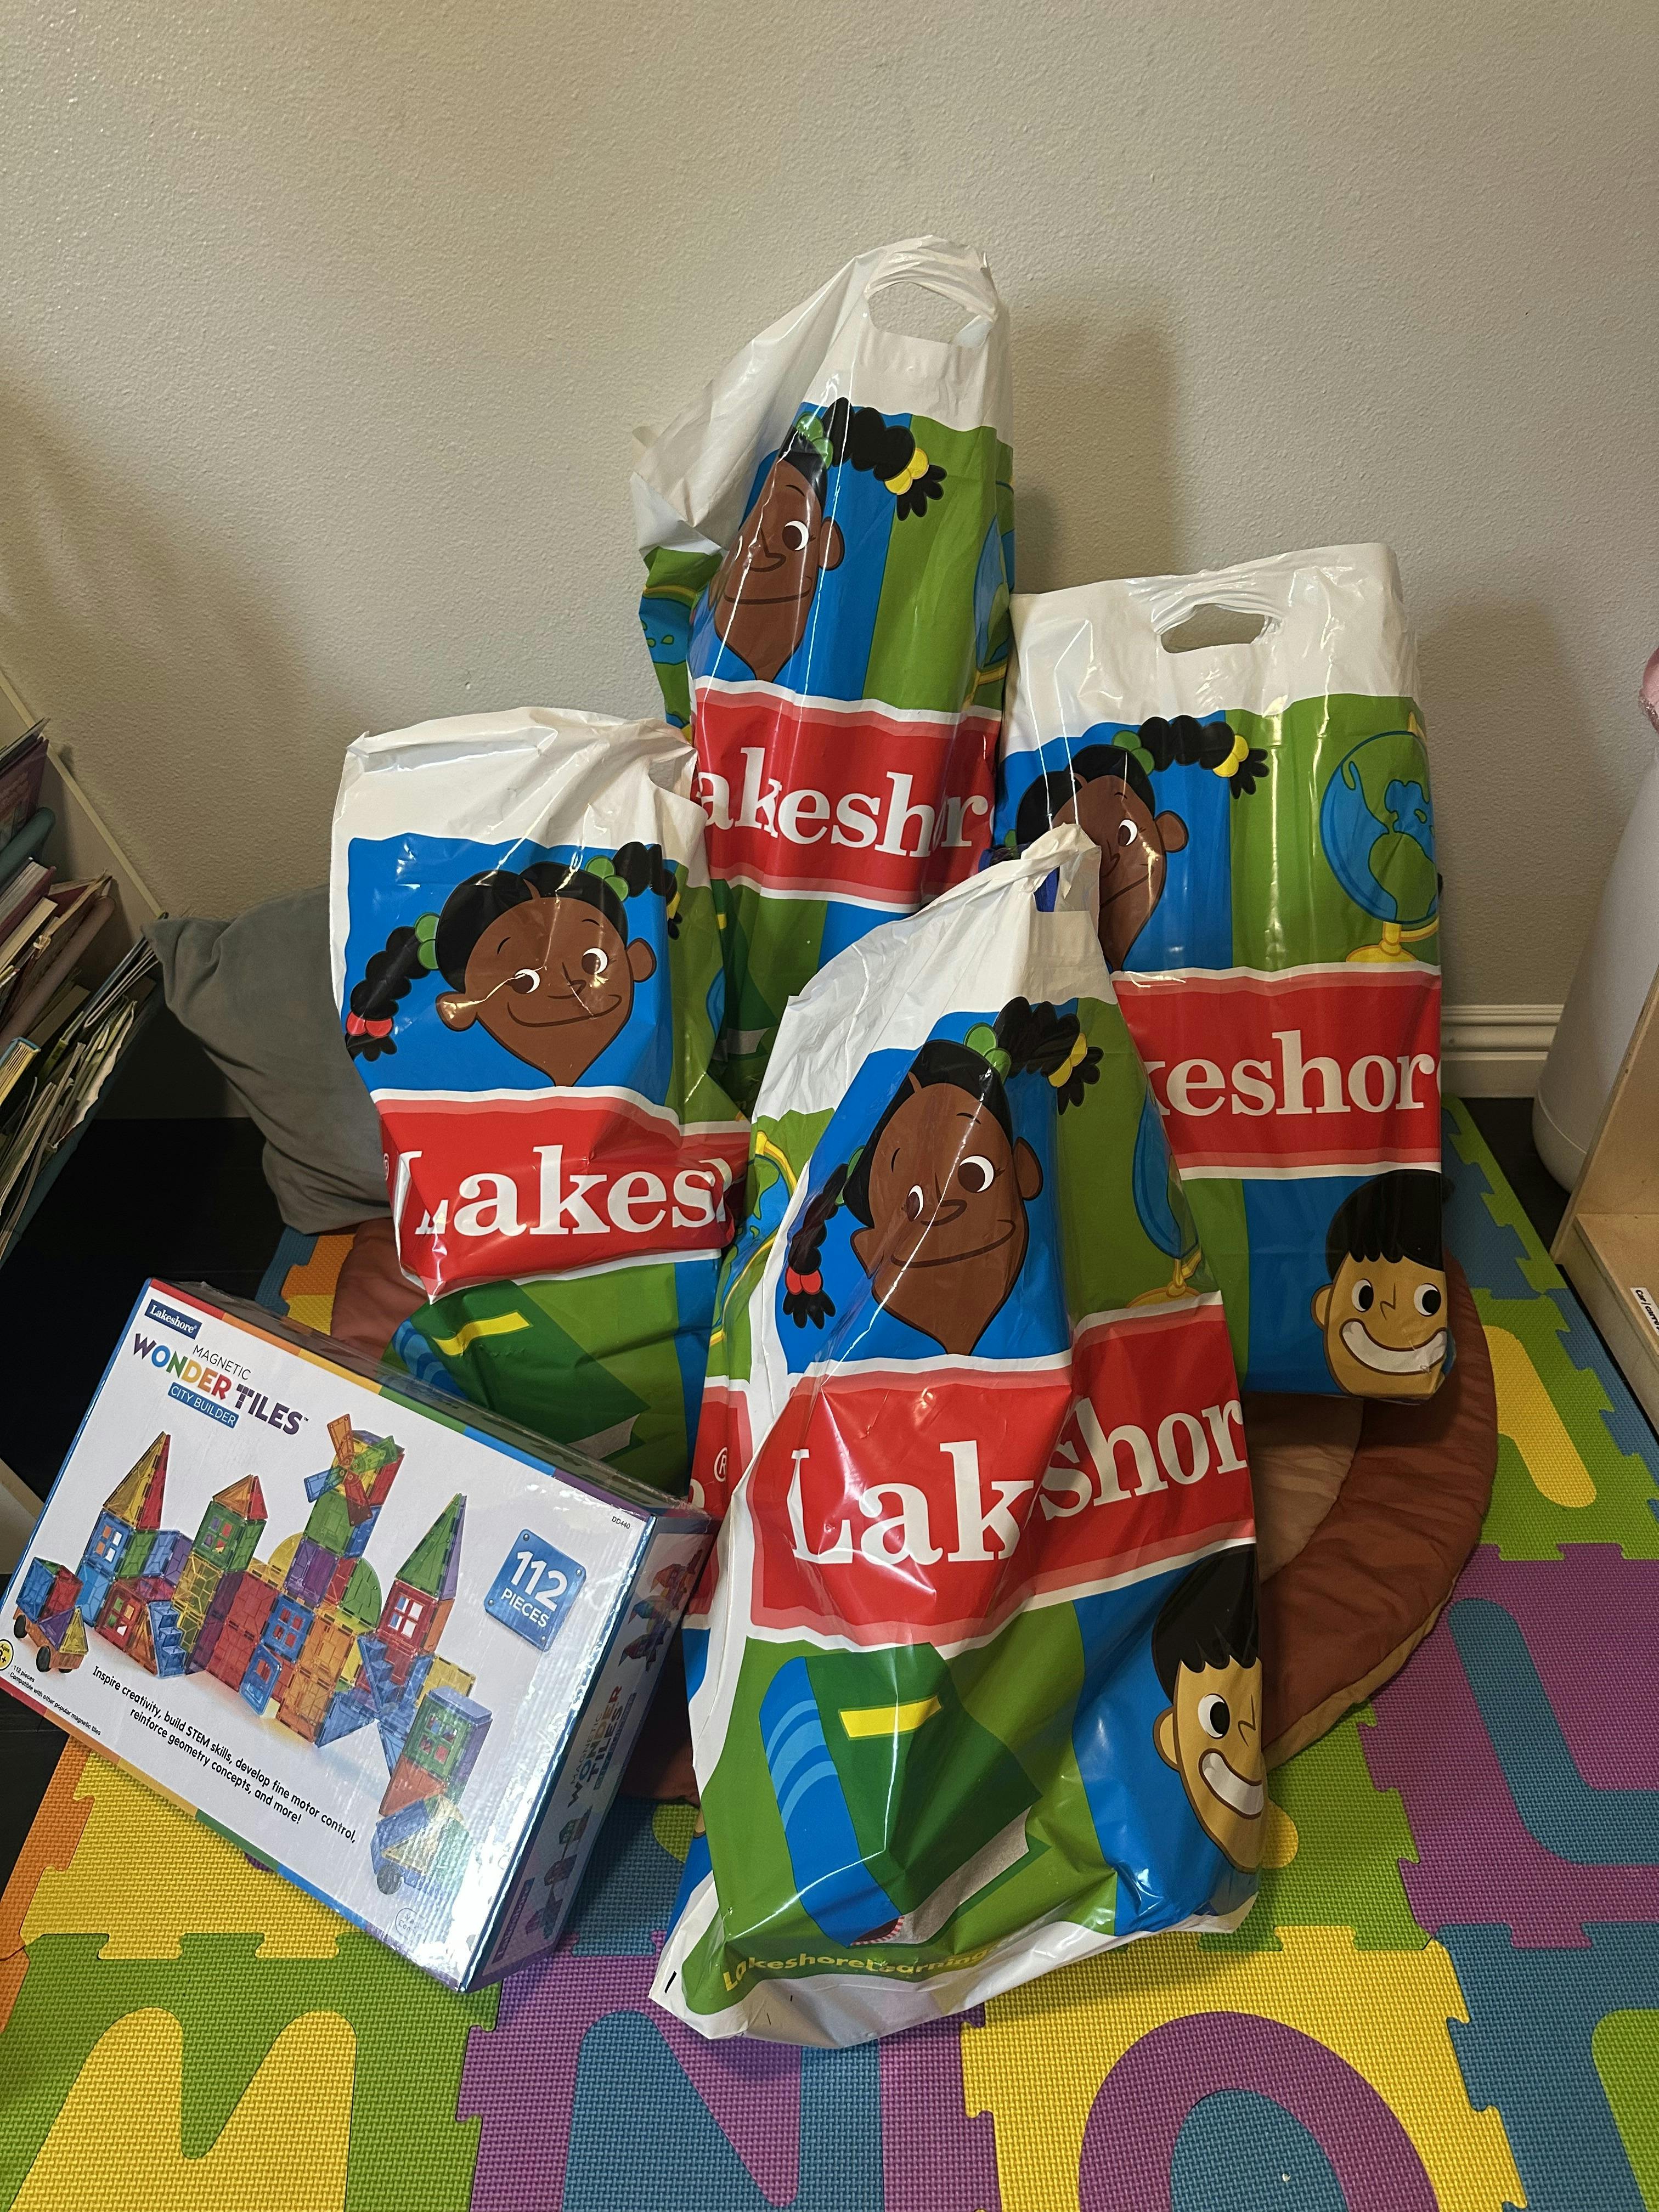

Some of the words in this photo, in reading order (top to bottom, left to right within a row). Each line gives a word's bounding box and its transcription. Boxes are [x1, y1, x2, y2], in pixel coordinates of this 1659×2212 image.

[133, 1333, 232, 1400] WONDER
[193, 1345, 251, 1380] MAGNETIC
[171, 1386, 193, 1402] CITY
[194, 1398, 236, 1425] BUILDER
[501, 1588, 550, 1628] PIECES
[511, 1551, 567, 1611] 112
[10, 1672, 33, 1691] Compatible
[33, 1688, 43, 1697] with
[43, 1694, 55, 1705] other
[54, 1702, 71, 1716] popular
[71, 1713, 92, 1729] magnetic
[92, 1726, 101, 1736] tiles
[20, 1670, 35, 1683] pieces
[92, 1666, 121, 1690] Inspire
[122, 1686, 161, 1720] creativity,
[164, 1711, 187, 1732] build
[186, 1726, 211, 1749] STEM
[210, 1740, 233, 1764] skills,
[235, 1758, 270, 1787] develop
[272, 1780, 290, 1799] fine
[291, 1793, 320, 1818] motor
[321, 1812, 357, 1843] control,
[130, 1708, 168, 1738] reinforce
[167, 1733, 211, 1767] geometry
[211, 1760, 252, 1795] concepts,
[254, 1788, 273, 1805] and
[273, 1802, 302, 1824] more!
[567, 1685, 622, 1808] WONDER
